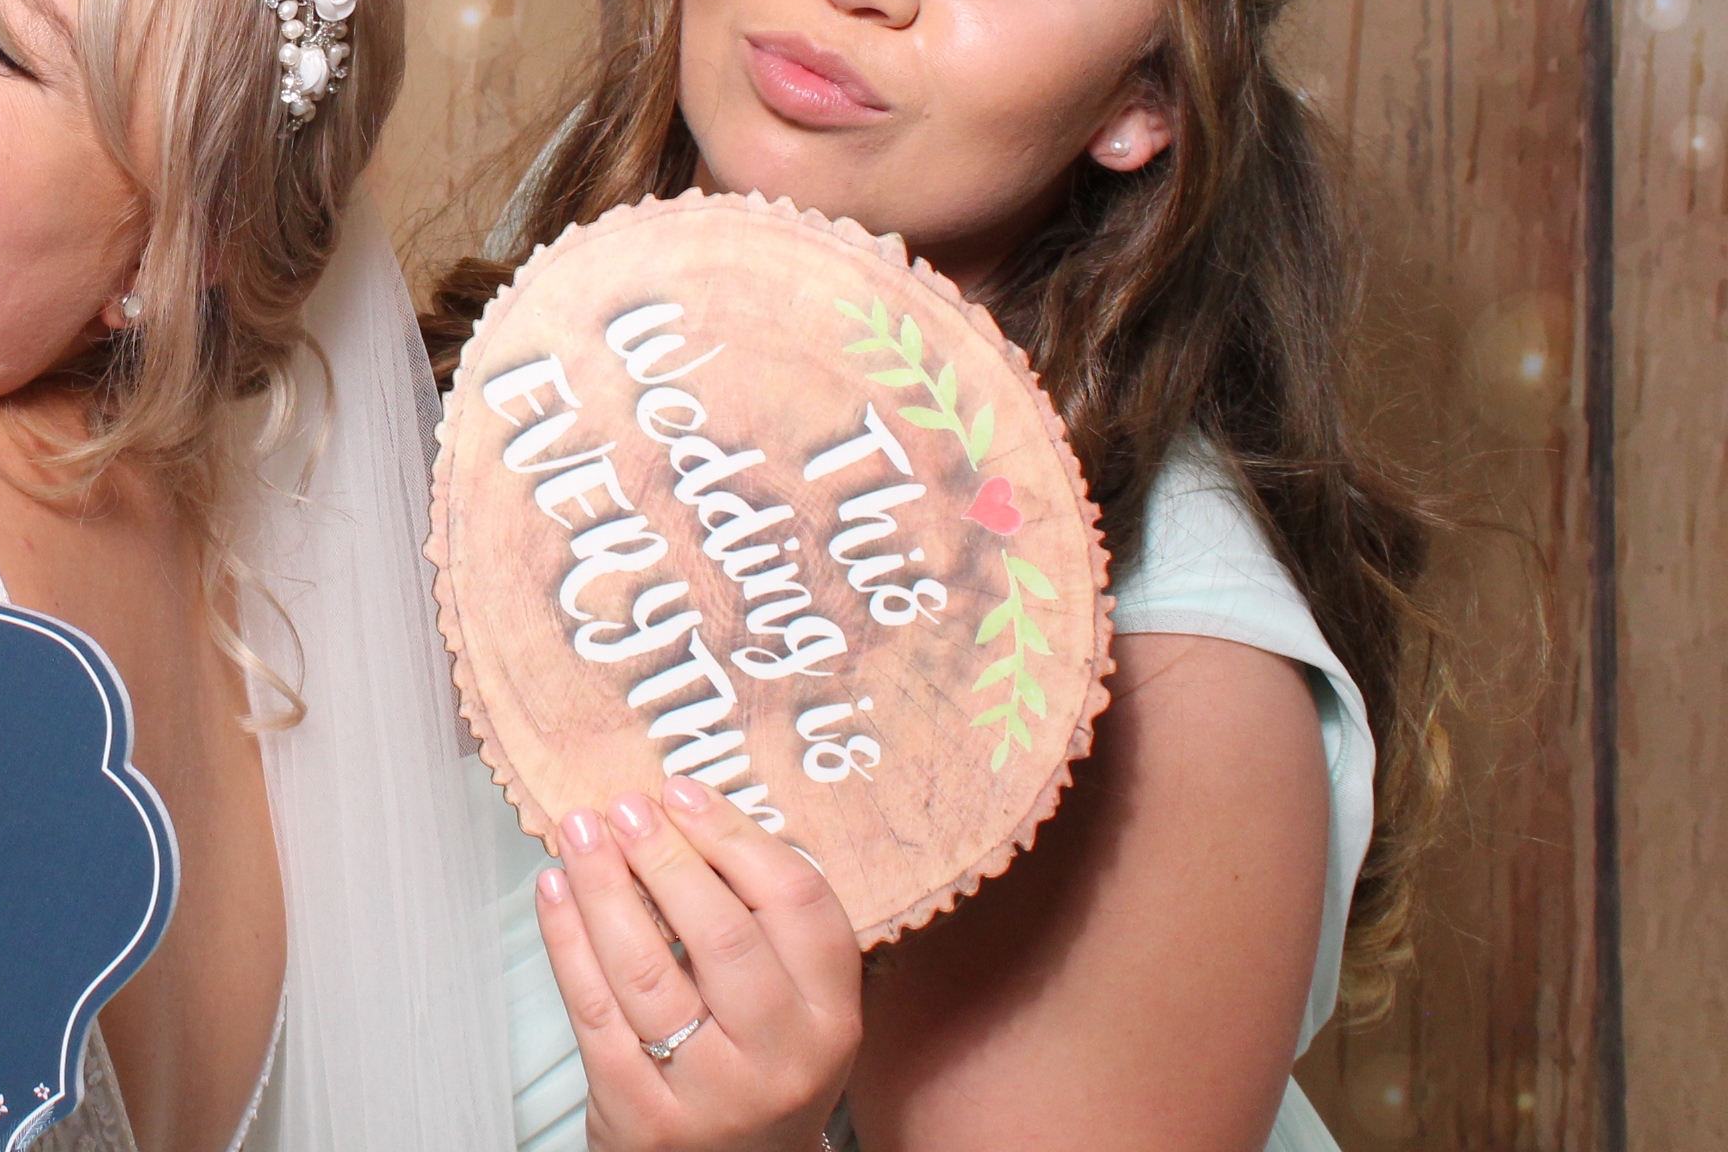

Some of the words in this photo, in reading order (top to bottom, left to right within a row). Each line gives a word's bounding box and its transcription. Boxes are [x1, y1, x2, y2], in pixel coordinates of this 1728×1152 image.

[605, 303, 848, 679] Wedding
[796, 696, 880, 783] is
[802, 402, 947, 627] This
